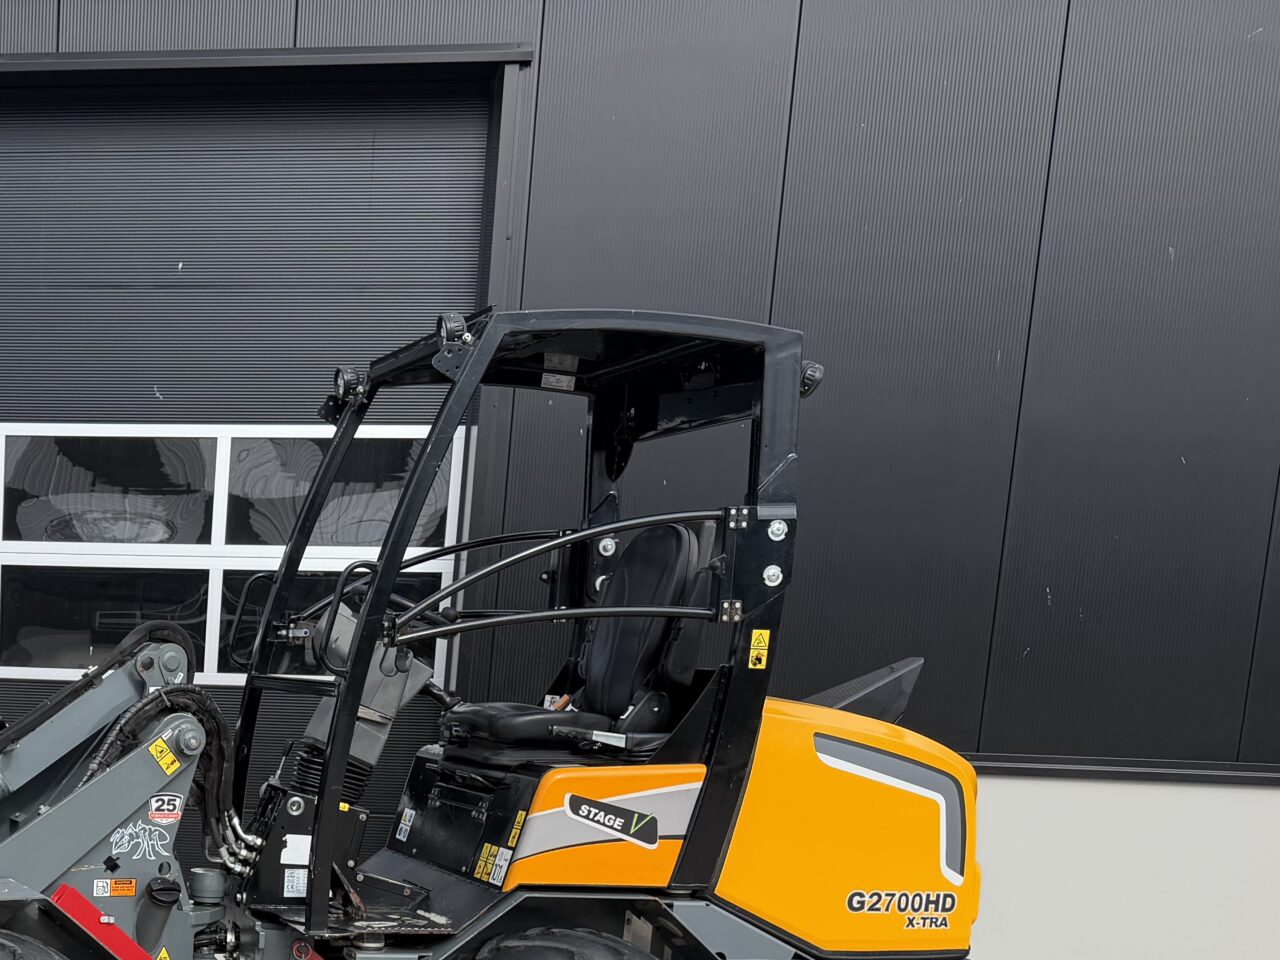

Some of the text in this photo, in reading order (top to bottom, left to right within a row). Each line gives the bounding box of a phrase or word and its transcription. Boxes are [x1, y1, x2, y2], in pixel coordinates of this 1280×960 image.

[154, 798, 176, 812] 25
[578, 804, 655, 834] STAGE V
[846, 891, 956, 913] G2700HD
[906, 916, 948, 928] X-TRA
